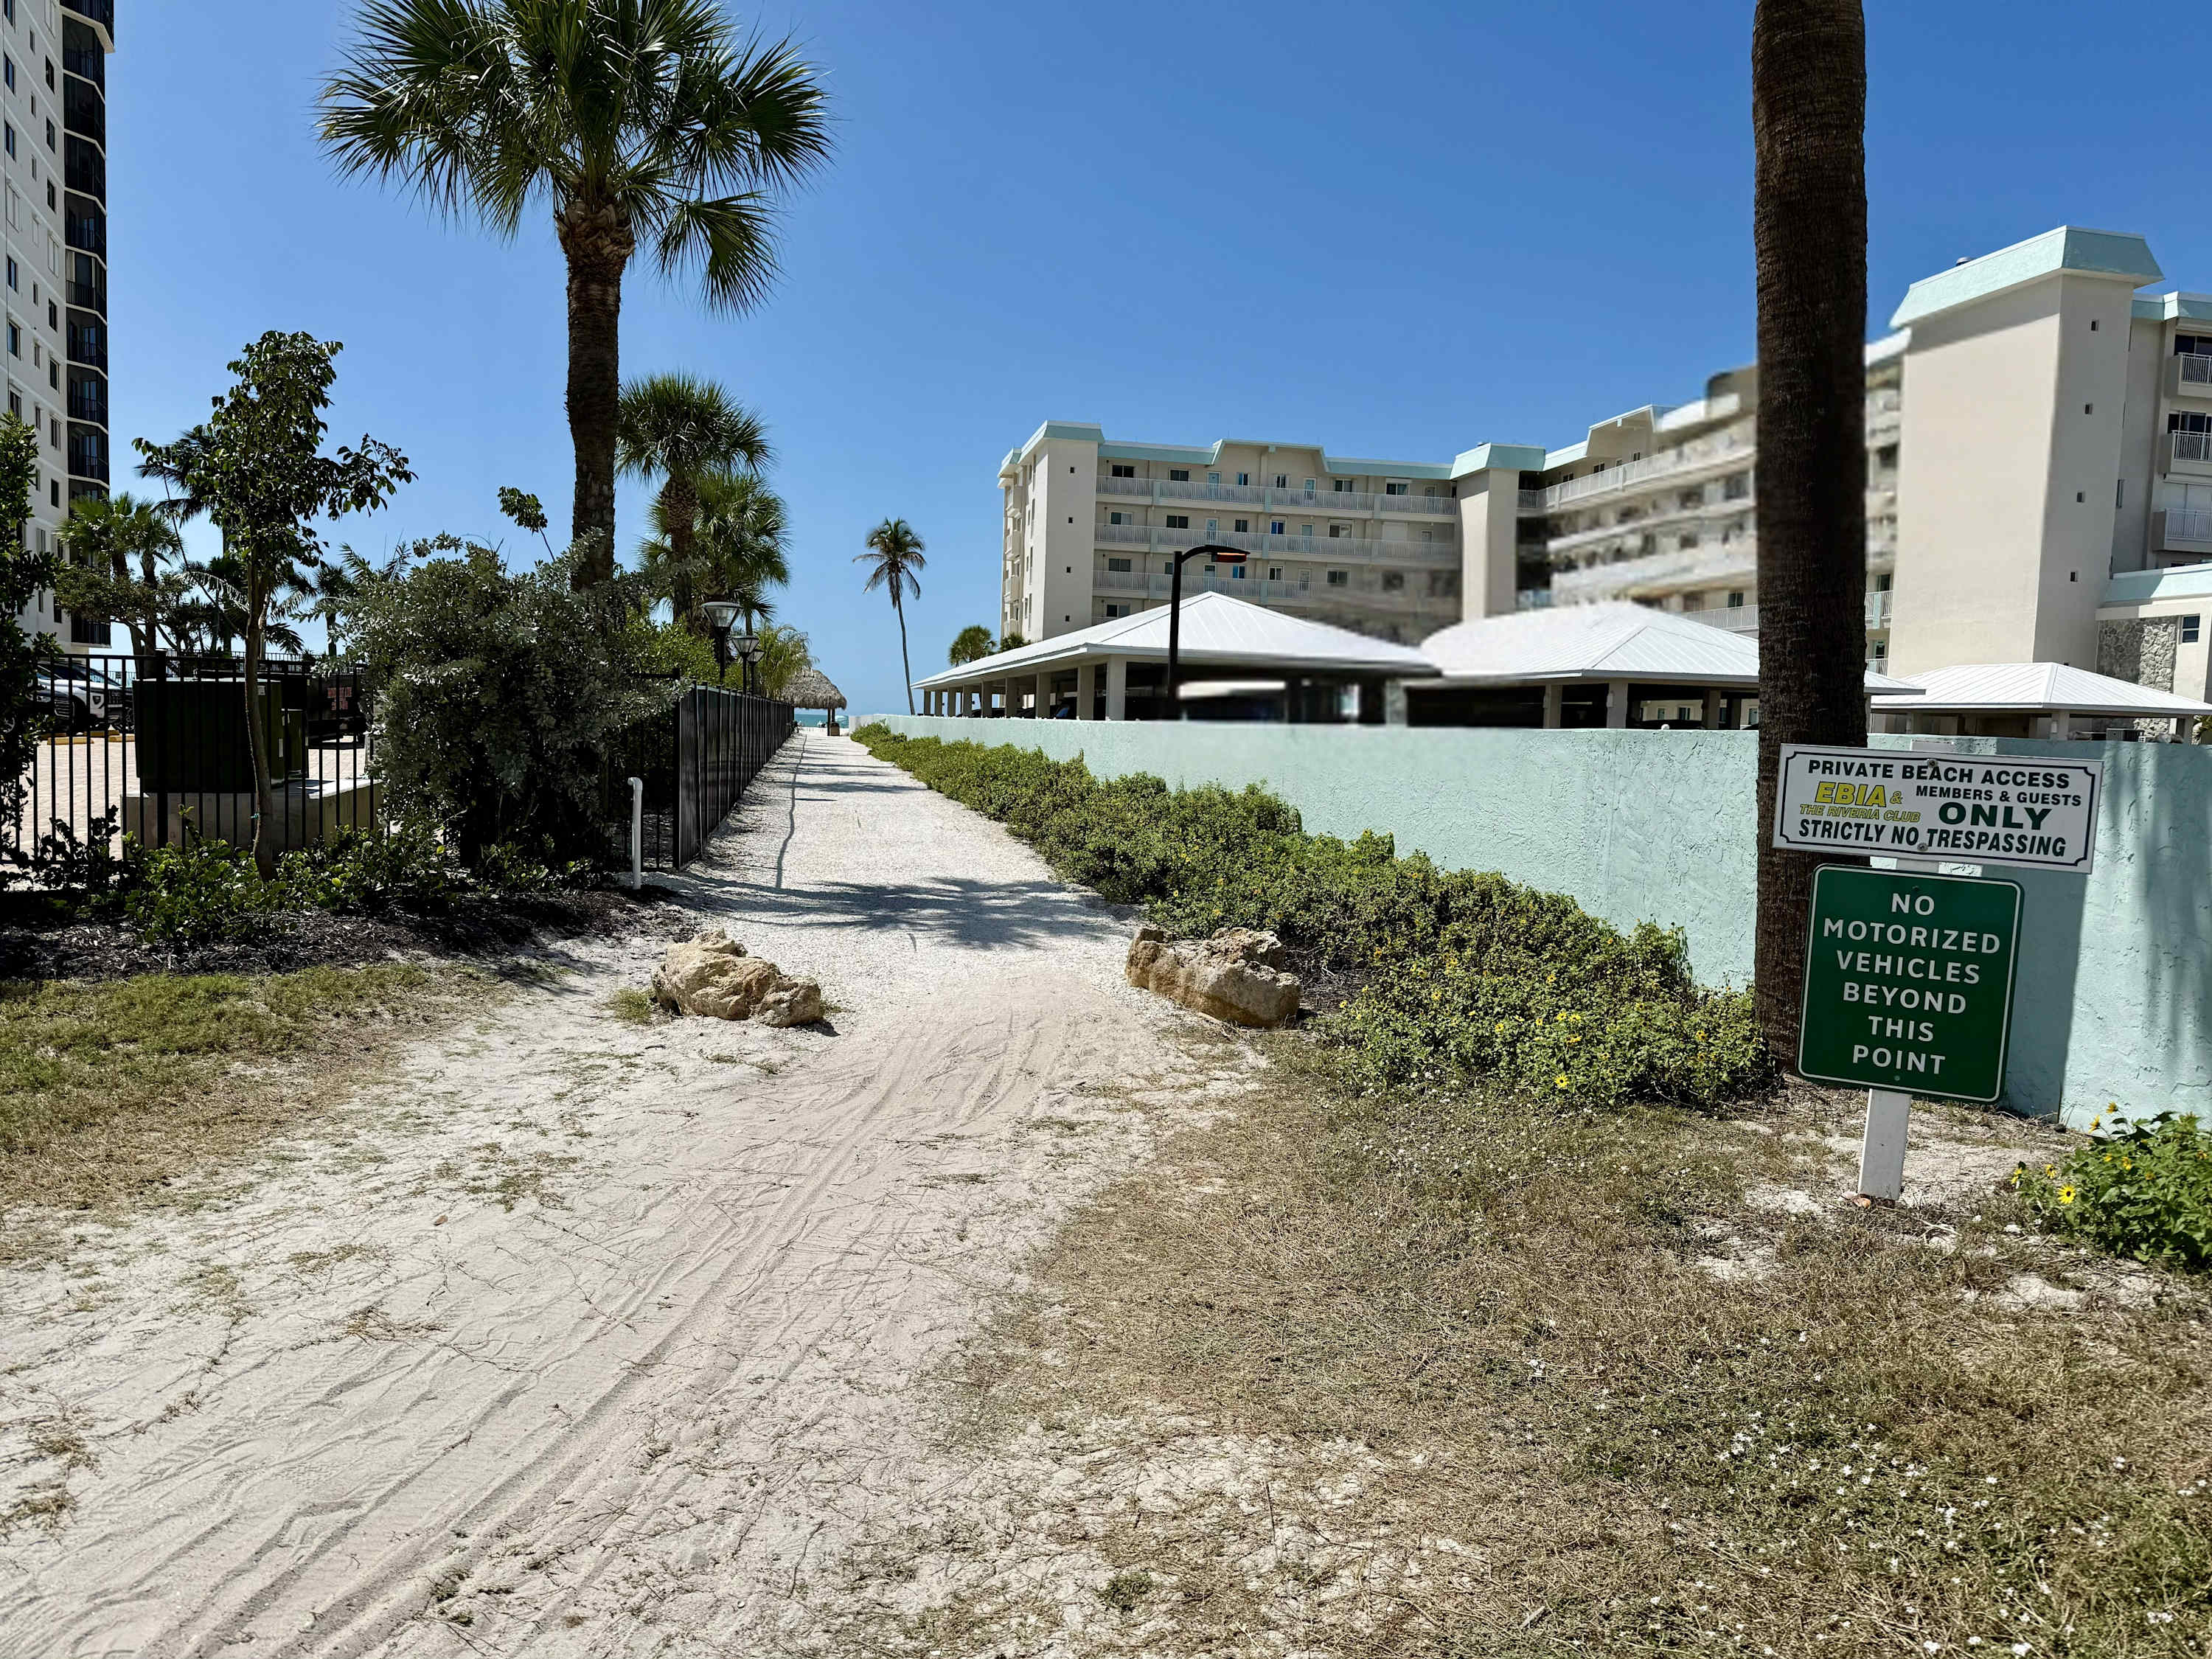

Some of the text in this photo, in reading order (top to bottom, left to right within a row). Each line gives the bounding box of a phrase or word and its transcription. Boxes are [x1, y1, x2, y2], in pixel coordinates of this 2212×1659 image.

[1808, 759, 2070, 789] PRIVATE BEACH ACCESS
[1815, 781, 1904, 808] EBIA &
[1916, 785, 2081, 807] MEMBERS & GUESTS
[1799, 804, 1921, 823] THE RIVERIA CLUB
[1938, 801, 2053, 830] ONLY
[1799, 818, 2066, 857] STRICTLY NO TRESPASSING
[1891, 893, 1935, 916] NO
[1823, 918, 2000, 954] MOTORIZED
[1836, 950, 1980, 984] VEHICLES
[1843, 981, 1966, 1014] BEYOND
[1868, 1015, 1935, 1043] THIS
[1852, 1044, 1946, 1074] POINT
